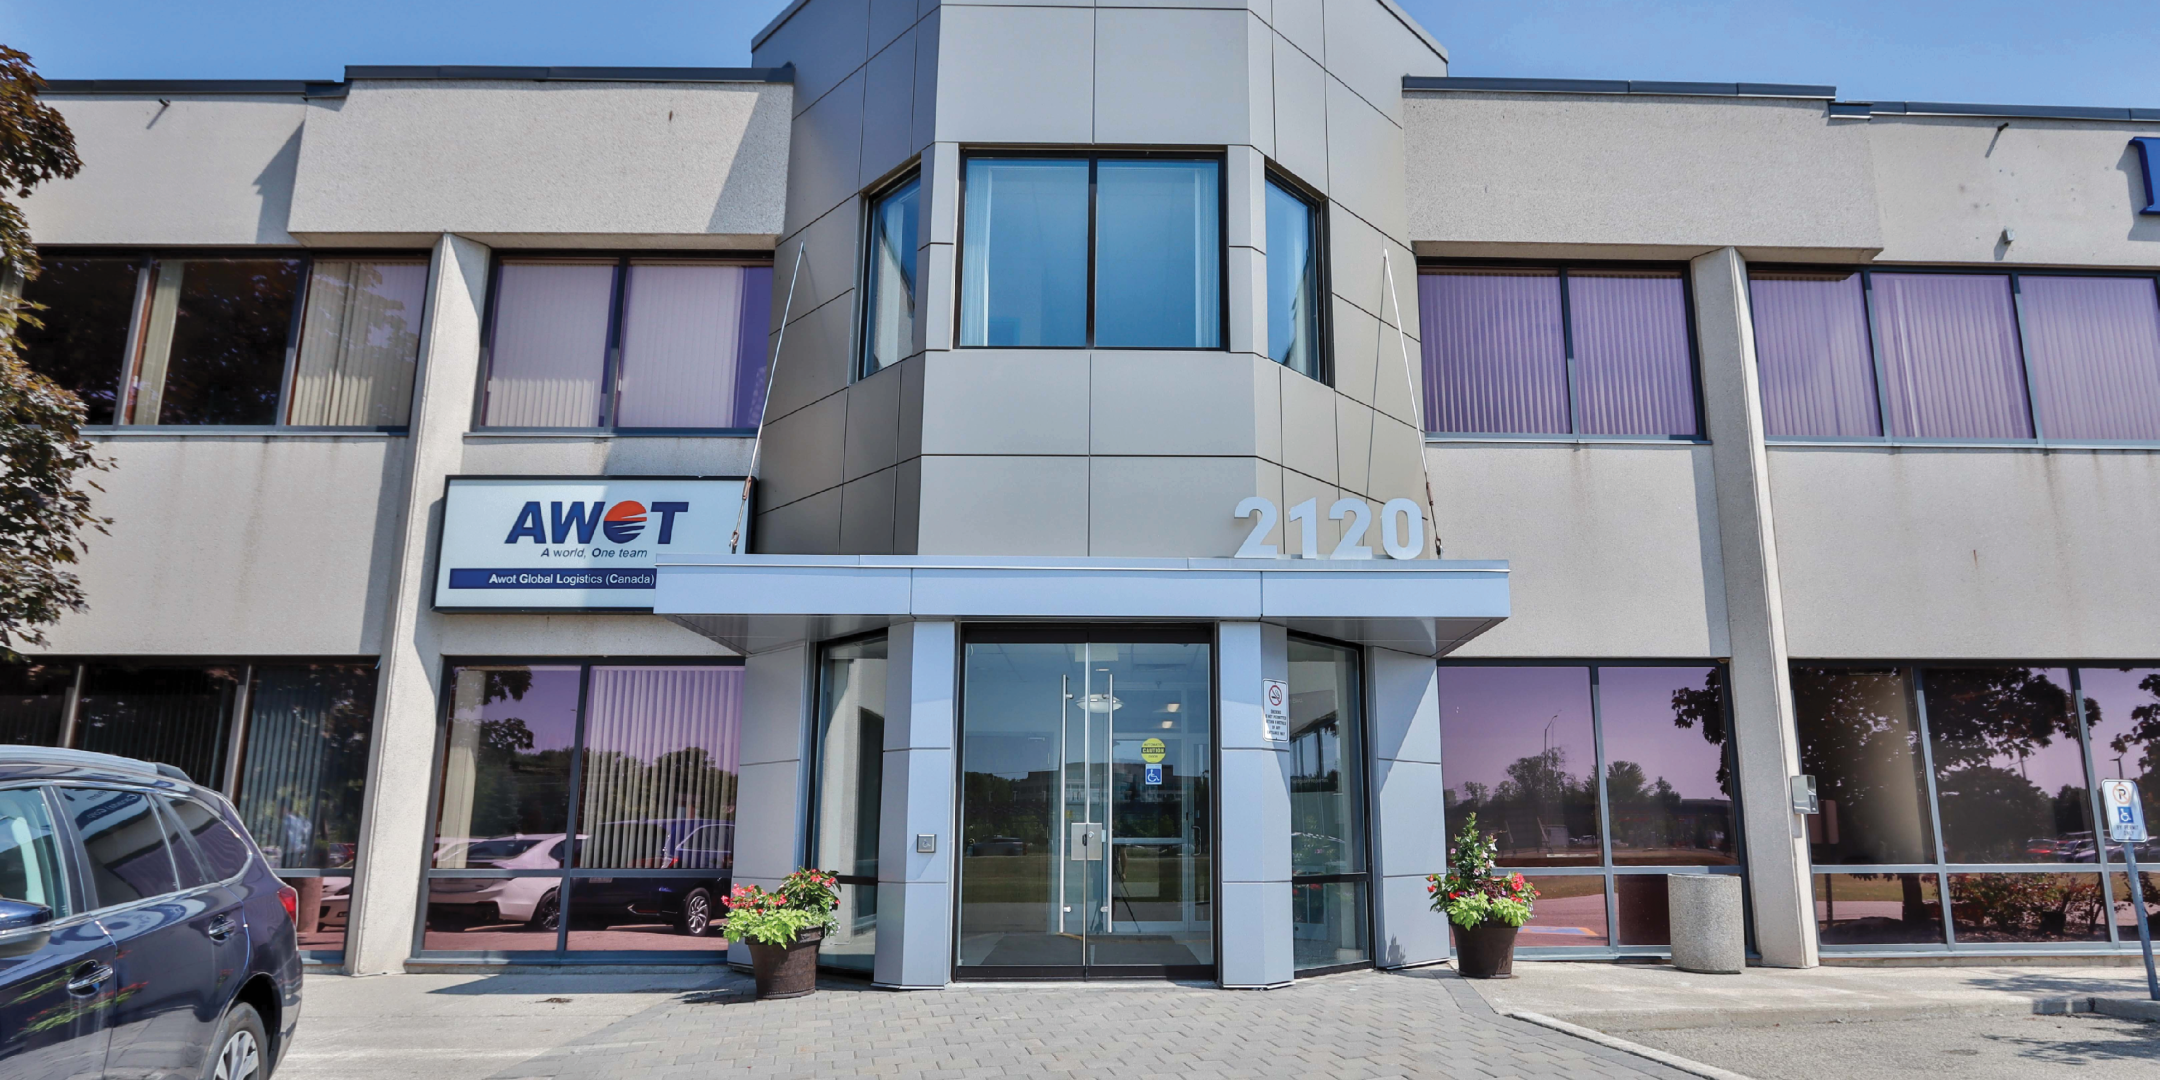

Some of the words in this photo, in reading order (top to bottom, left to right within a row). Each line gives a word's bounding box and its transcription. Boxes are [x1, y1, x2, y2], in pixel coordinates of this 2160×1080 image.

[504, 500, 689, 544] AWOT
[1234, 496, 1424, 560] 2120
[540, 548, 550, 558] A
[553, 548, 587, 559] world,
[591, 548, 615, 558] One
[618, 549, 648, 558] team
[489, 573, 517, 584] Awot
[519, 573, 553, 584] Global
[556, 573, 603, 587] Logistics
[605, 573, 655, 586] (Canada)
